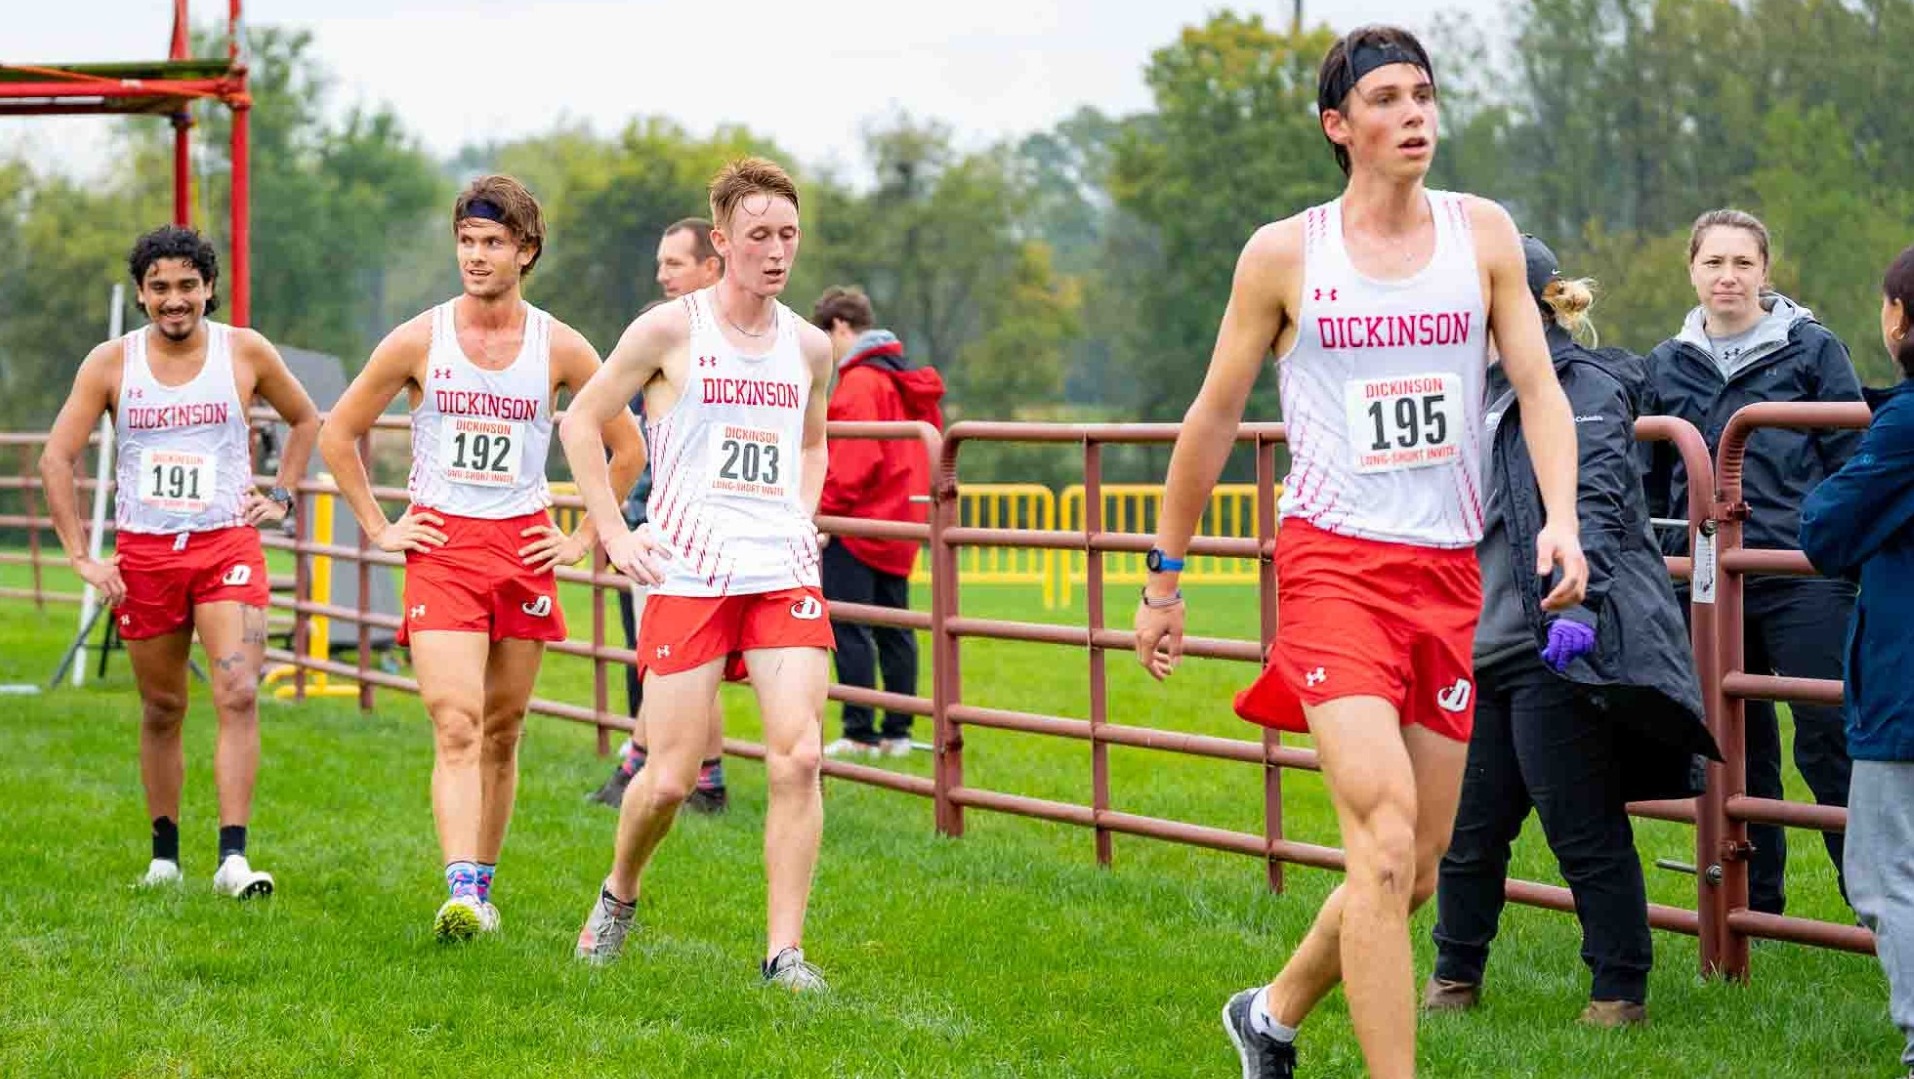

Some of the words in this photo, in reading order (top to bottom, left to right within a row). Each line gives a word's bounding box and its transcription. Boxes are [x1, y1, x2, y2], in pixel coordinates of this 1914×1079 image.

[1317, 312, 1471, 349] DICKINSON
[703, 378, 799, 409] DICKINSON
[1366, 378, 1444, 398] DICKINSON
[128, 402, 228, 430] DICKINSON
[435, 390, 539, 421] DICKINSON
[455, 419, 512, 435] DICKINSON
[725, 426, 779, 444] DICKINSON
[1368, 395, 1447, 450] 195
[452, 433, 511, 472] 192
[719, 440, 779, 485] 203
[152, 464, 201, 500] 191
[712, 480, 760, 495] LONG-SHORT
